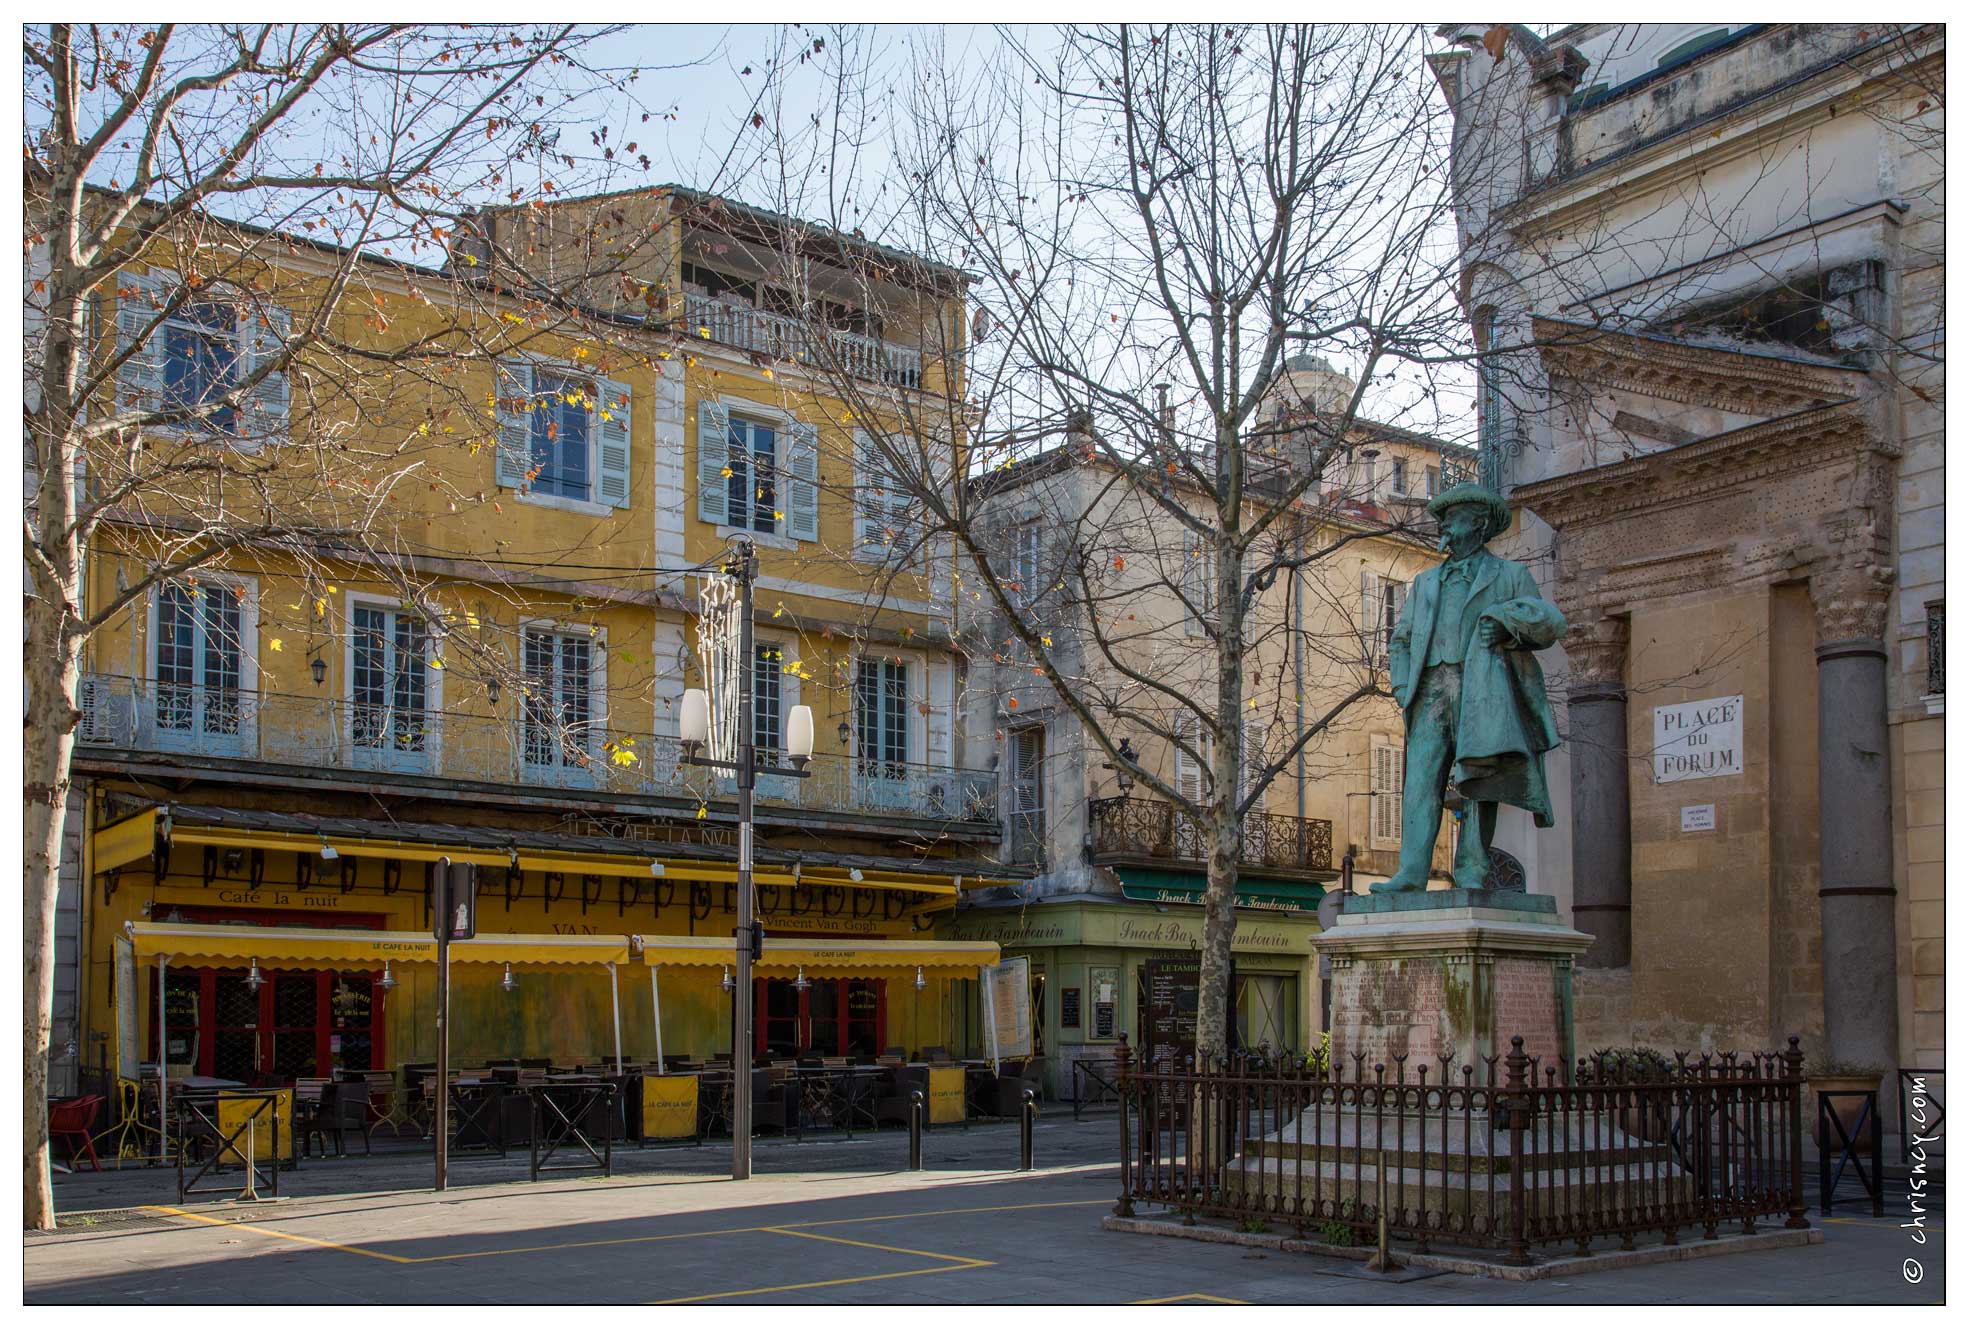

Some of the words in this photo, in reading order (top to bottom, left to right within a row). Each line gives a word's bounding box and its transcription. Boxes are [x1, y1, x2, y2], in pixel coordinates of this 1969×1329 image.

[1664, 705, 1735, 730] PLACE
[1687, 733, 1708, 746] DU
[1664, 749, 1733, 774] FORUM
[219, 890, 261, 904] Café
[274, 892, 289, 905] la
[304, 896, 338, 907] nuit
[1157, 889, 1191, 903] Snack
[1248, 896, 1300, 911] Tambourin
[767, 917, 812, 929] Vincent
[816, 919, 838, 930] Van
[844, 919, 877, 933] Gogh
[995, 919, 1065, 940] Tambourin
[1120, 919, 1162, 941] Snack
[1165, 922, 1193, 941] Bar
[1161, 965, 1171, 973] LE
